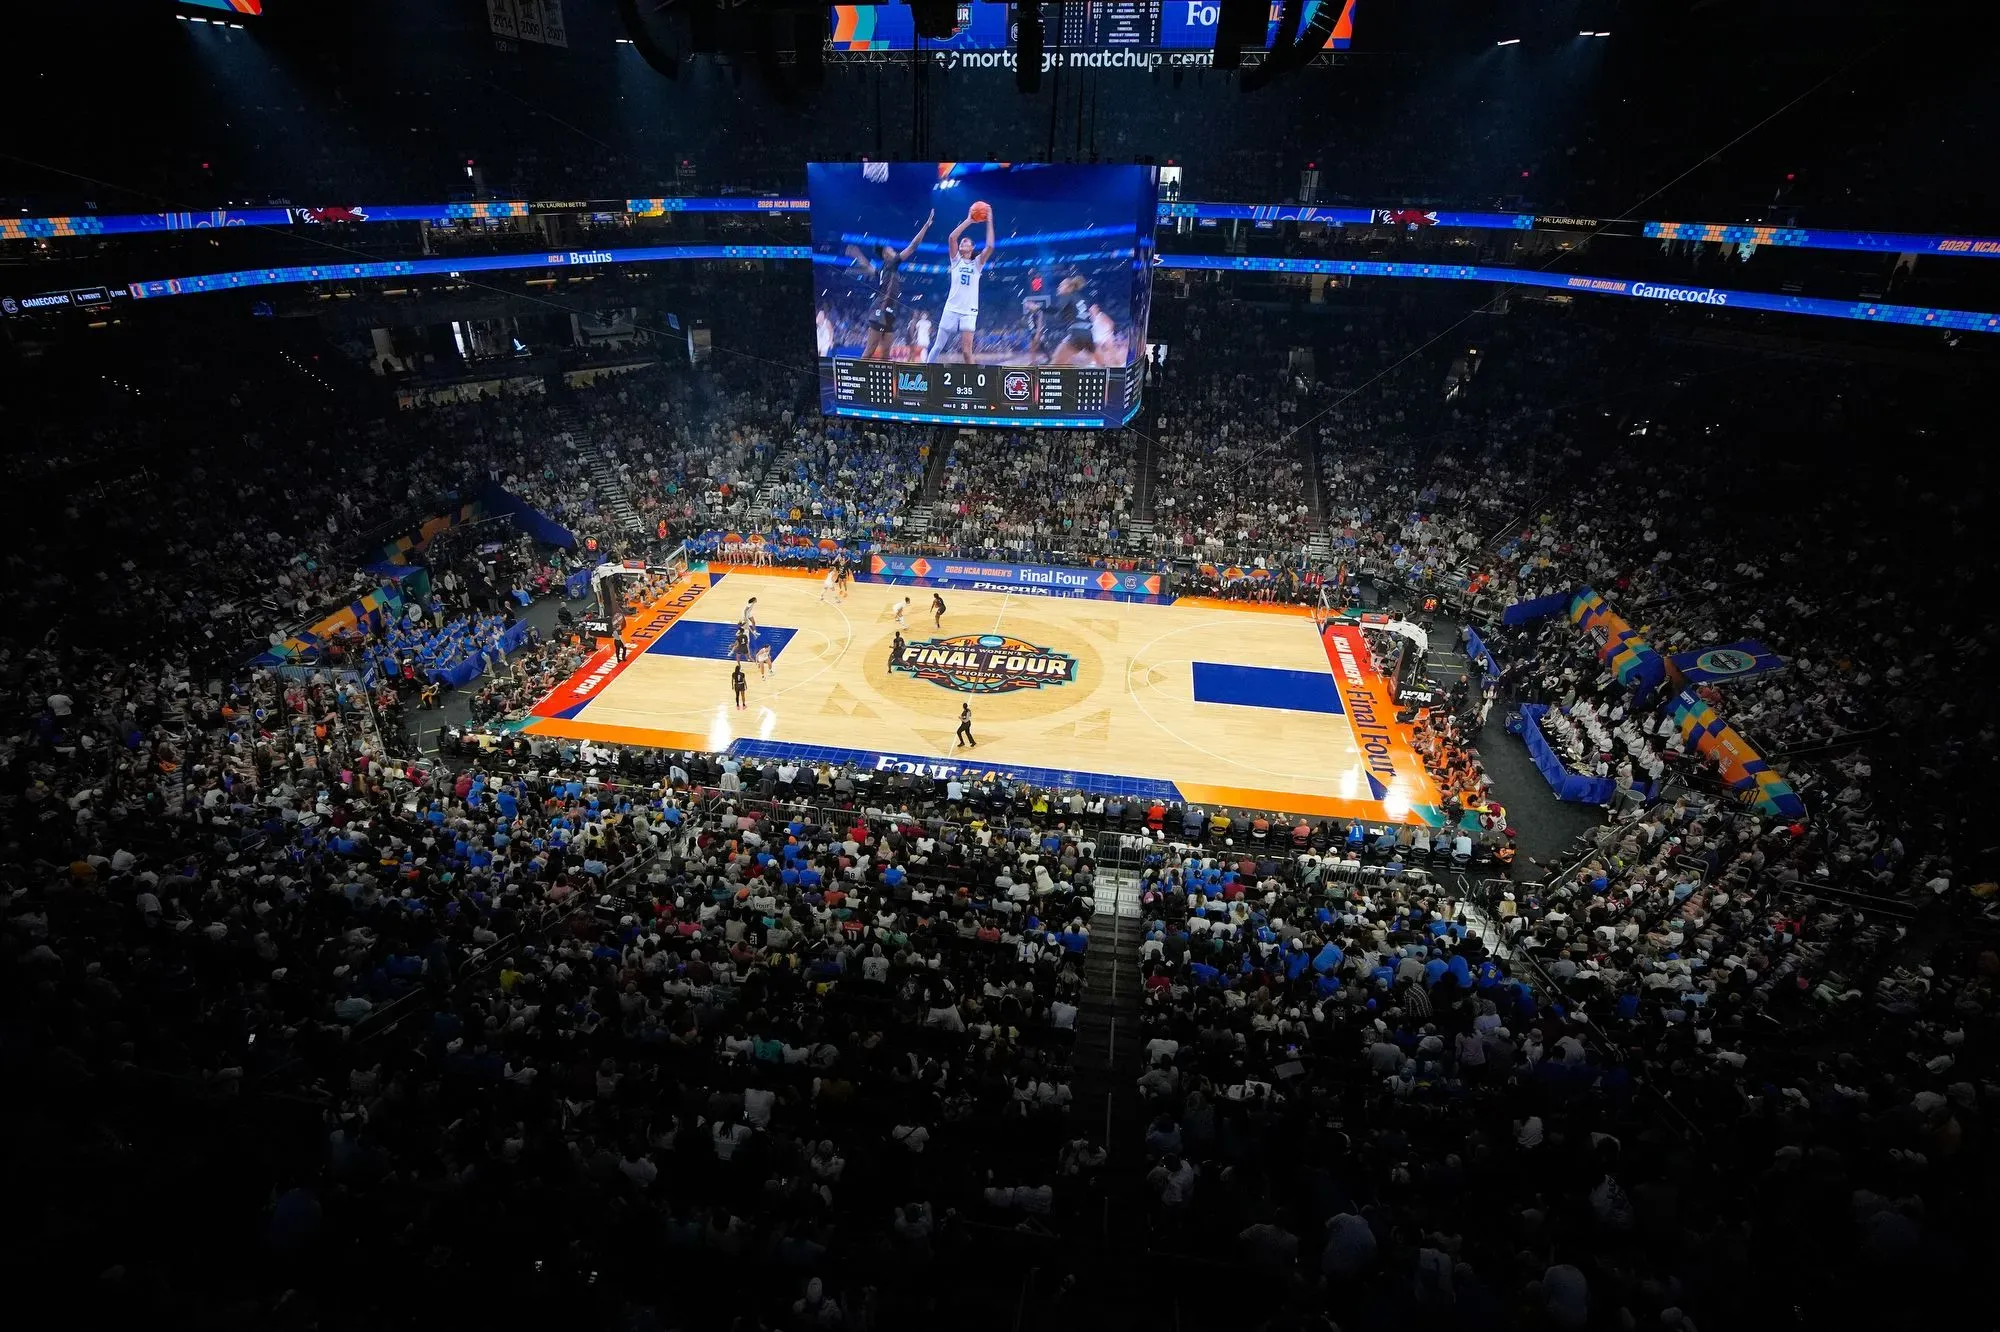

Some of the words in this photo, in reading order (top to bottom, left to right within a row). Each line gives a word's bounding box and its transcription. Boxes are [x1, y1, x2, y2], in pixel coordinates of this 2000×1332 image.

[1186, 1, 1220, 26] Fo
[1070, 48, 1162, 72] matchup
[774, 200, 789, 208] NCAA
[1552, 217, 1576, 225] LAUREN
[1938, 240, 1972, 252] 2026
[548, 254, 564, 263] UCLA
[570, 250, 613, 264] Bruins
[960, 274, 970, 286] 51
[1568, 277, 1591, 288] SOUTH
[1591, 280, 1626, 292] CAROLINA
[1632, 282, 1727, 305] Gamecocks
[21, 295, 69, 308] GAMECOCKS
[943, 373, 952, 386] 2
[977, 374, 986, 387] 0
[956, 387, 973, 395] 9:35
[945, 565, 963, 574] 2026
[963, 567, 981, 575] NCAA
[981, 568, 1012, 578] WOMEN'S
[1019, 569, 1053, 583] Final
[1055, 571, 1088, 586] Four
[972, 582, 1049, 595] Phoenix
[573, 674, 605, 695] NCAA
[630, 609, 677, 639] Final
[666, 584, 706, 608] Four
[979, 648, 1022, 656] WOMEN'S
[902, 647, 980, 668] FINAL
[988, 654, 1067, 675] FOUR
[954, 669, 1004, 679] PHOENIX
[1399, 689, 1432, 703] NCAA
[1346, 690, 1388, 729] Final
[1361, 733, 1397, 777] Four
[875, 755, 957, 780] Four
[750, 933, 758, 945] 21
[792, 1001, 804, 1012] 22
